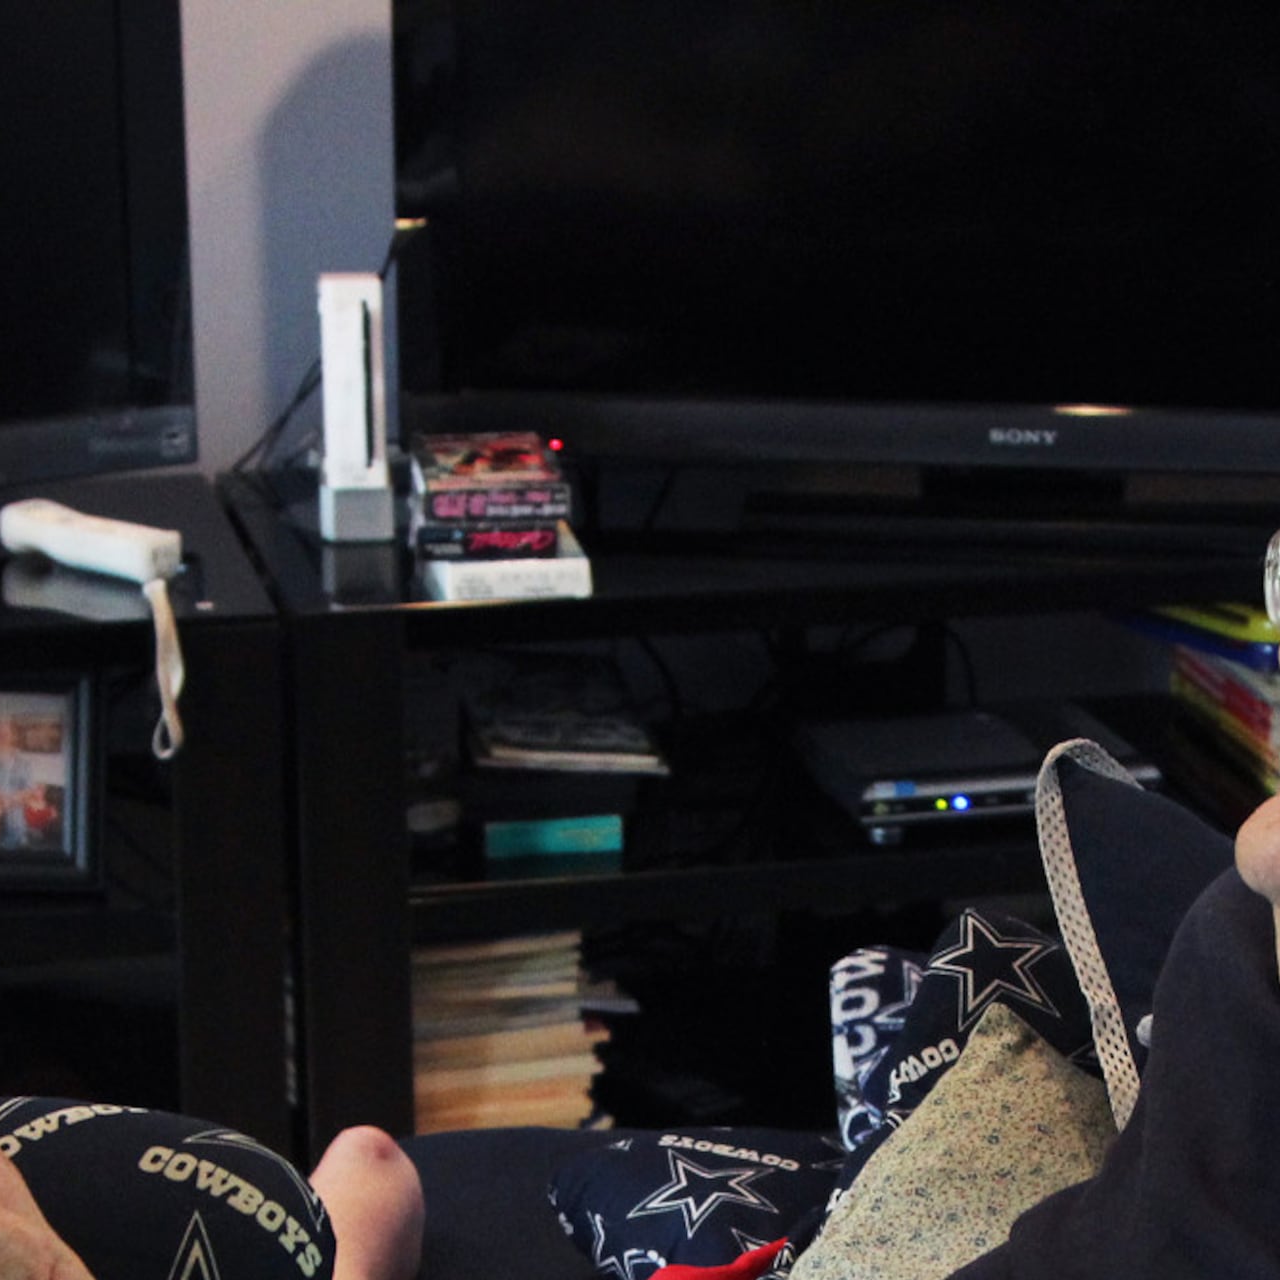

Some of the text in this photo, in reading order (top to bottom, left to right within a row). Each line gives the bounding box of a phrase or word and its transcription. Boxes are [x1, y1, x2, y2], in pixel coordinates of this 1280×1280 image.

[988, 427, 1058, 447] SONY
[658, 1133, 801, 1172] COWBOYS
[137, 1145, 322, 1279] COWBOYS
